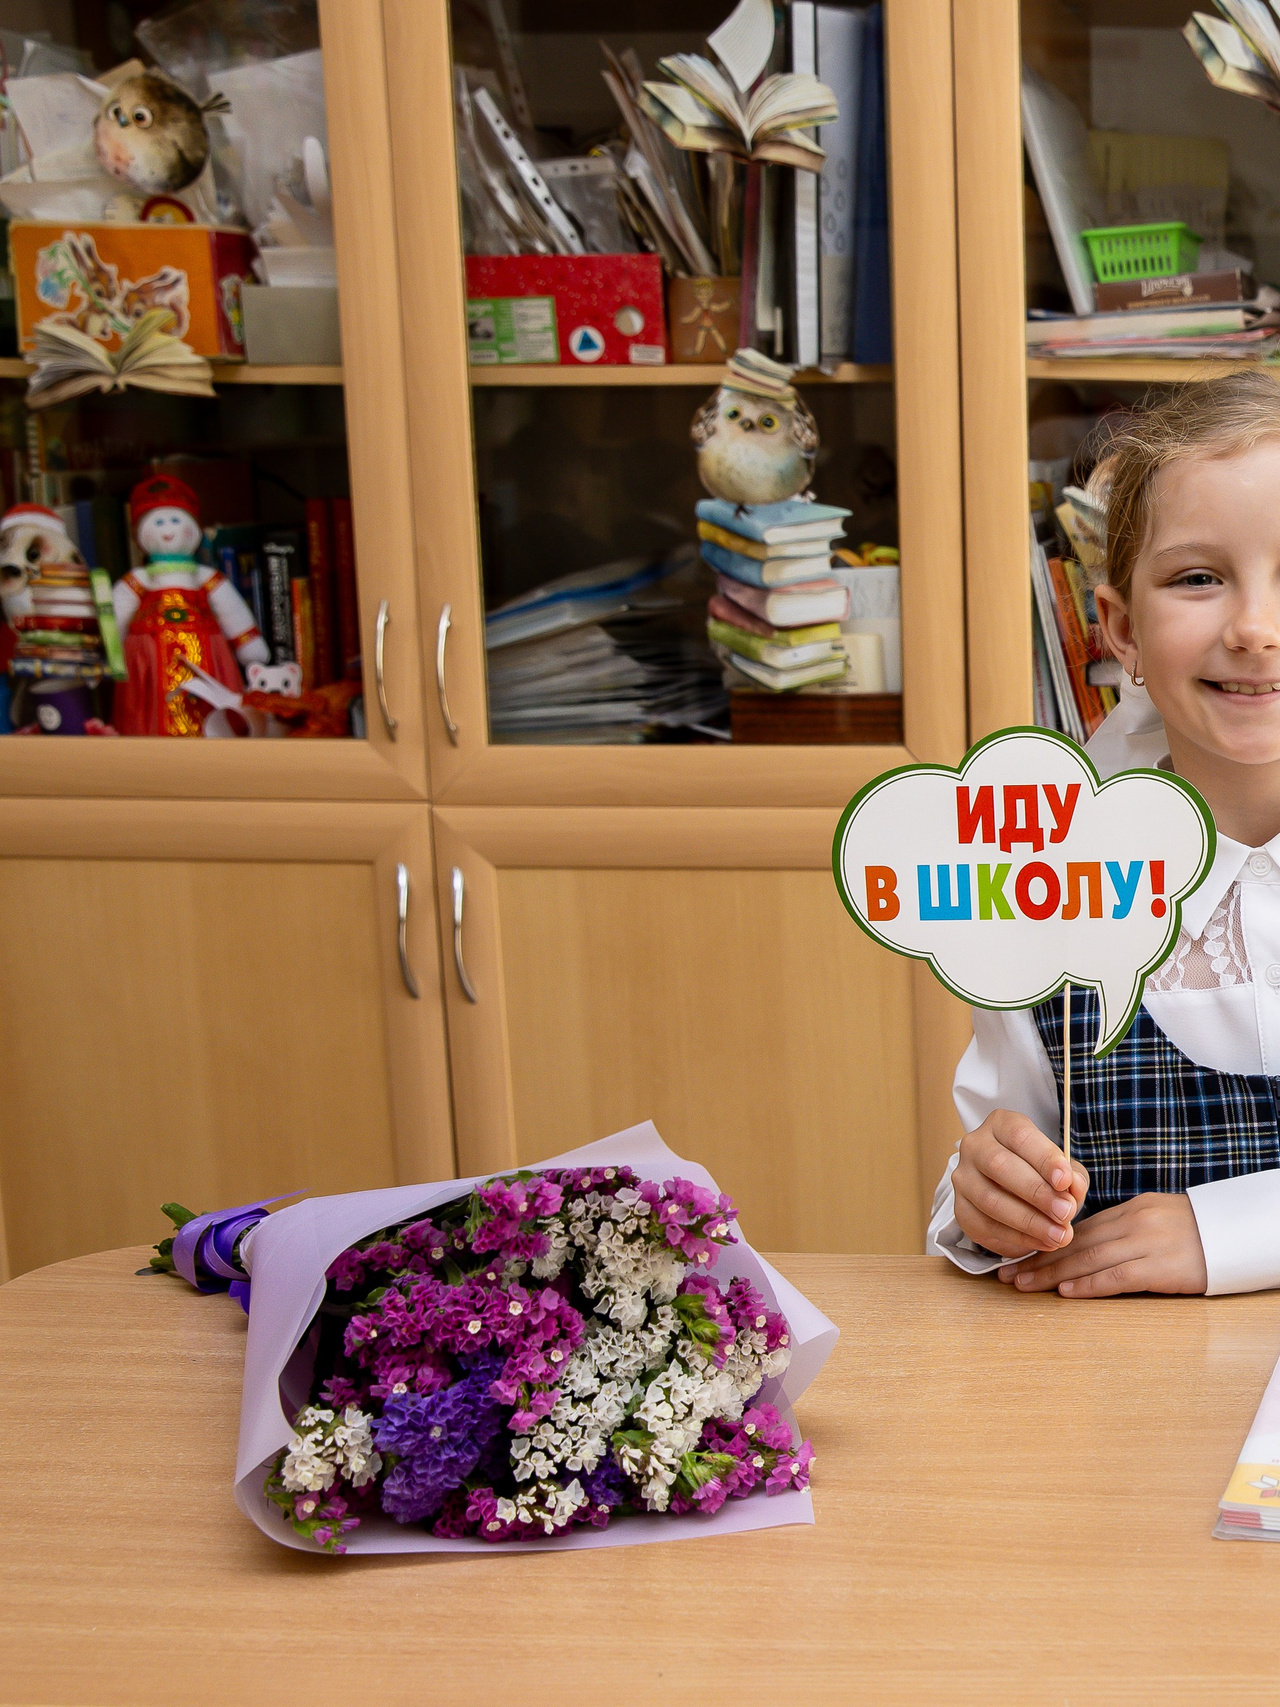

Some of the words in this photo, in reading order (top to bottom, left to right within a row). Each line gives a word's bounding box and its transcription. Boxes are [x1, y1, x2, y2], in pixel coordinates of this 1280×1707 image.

[955, 783, 1081, 854] ИДУ
[864, 865, 901, 922] В
[916, 860, 1167, 922] ШКОЛУ!
